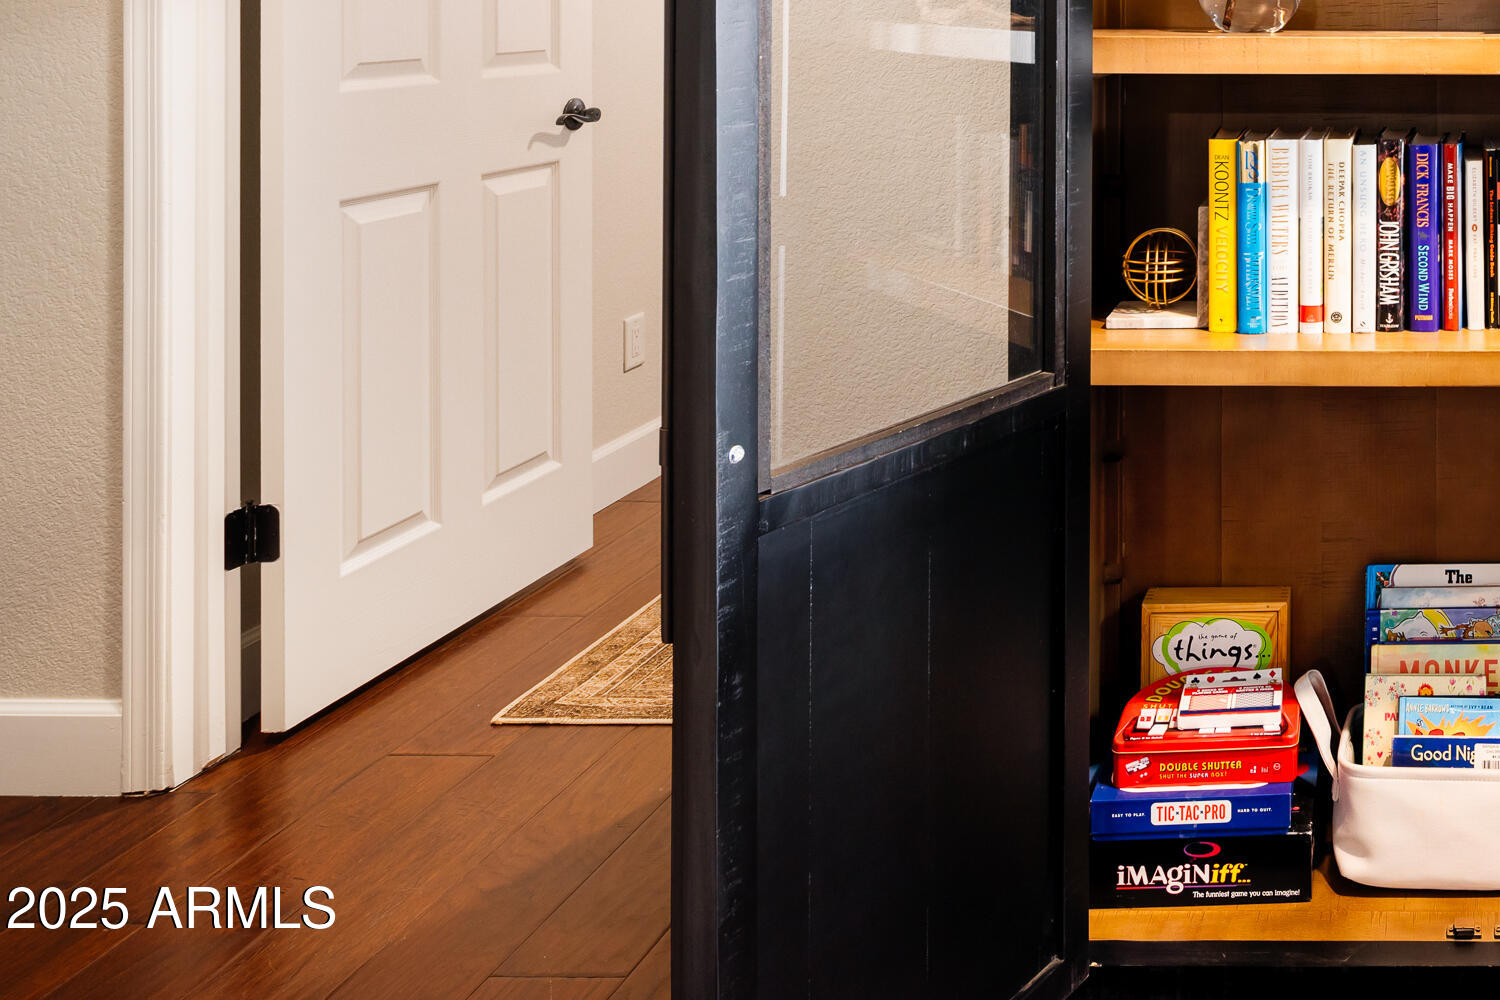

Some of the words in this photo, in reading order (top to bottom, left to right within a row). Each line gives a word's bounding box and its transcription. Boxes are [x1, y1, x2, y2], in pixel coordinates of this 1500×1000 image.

[1360, 150, 1367, 166] AN
[1416, 152, 1429, 180] DICK
[1272, 148, 1289, 198] BARBARA
[1214, 161, 1229, 220] KOONTZ
[1446, 186, 1455, 200] BIG
[1416, 184, 1430, 228] FRANCIS
[1272, 203, 1289, 254] WALTERS
[1328, 227, 1335, 240] OF
[1378, 219, 1400, 250] JOHN
[1216, 226, 1229, 292] VELOCITY
[1418, 245, 1430, 281] SECOND
[1379, 252, 1400, 305] GRISHAM
[1272, 276, 1288, 327] AUDITION
[1418, 284, 1430, 311] WIND
[1445, 570, 1472, 584] The
[1230, 632, 1238, 640] of
[1160, 762, 1199, 772] DOUBLE
[1202, 760, 1242, 771] SHUTTER
[1411, 744, 1452, 761] Good
[1456, 744, 1476, 765] Nig
[1192, 890, 1205, 898] The
[1205, 890, 1230, 898] funniest
